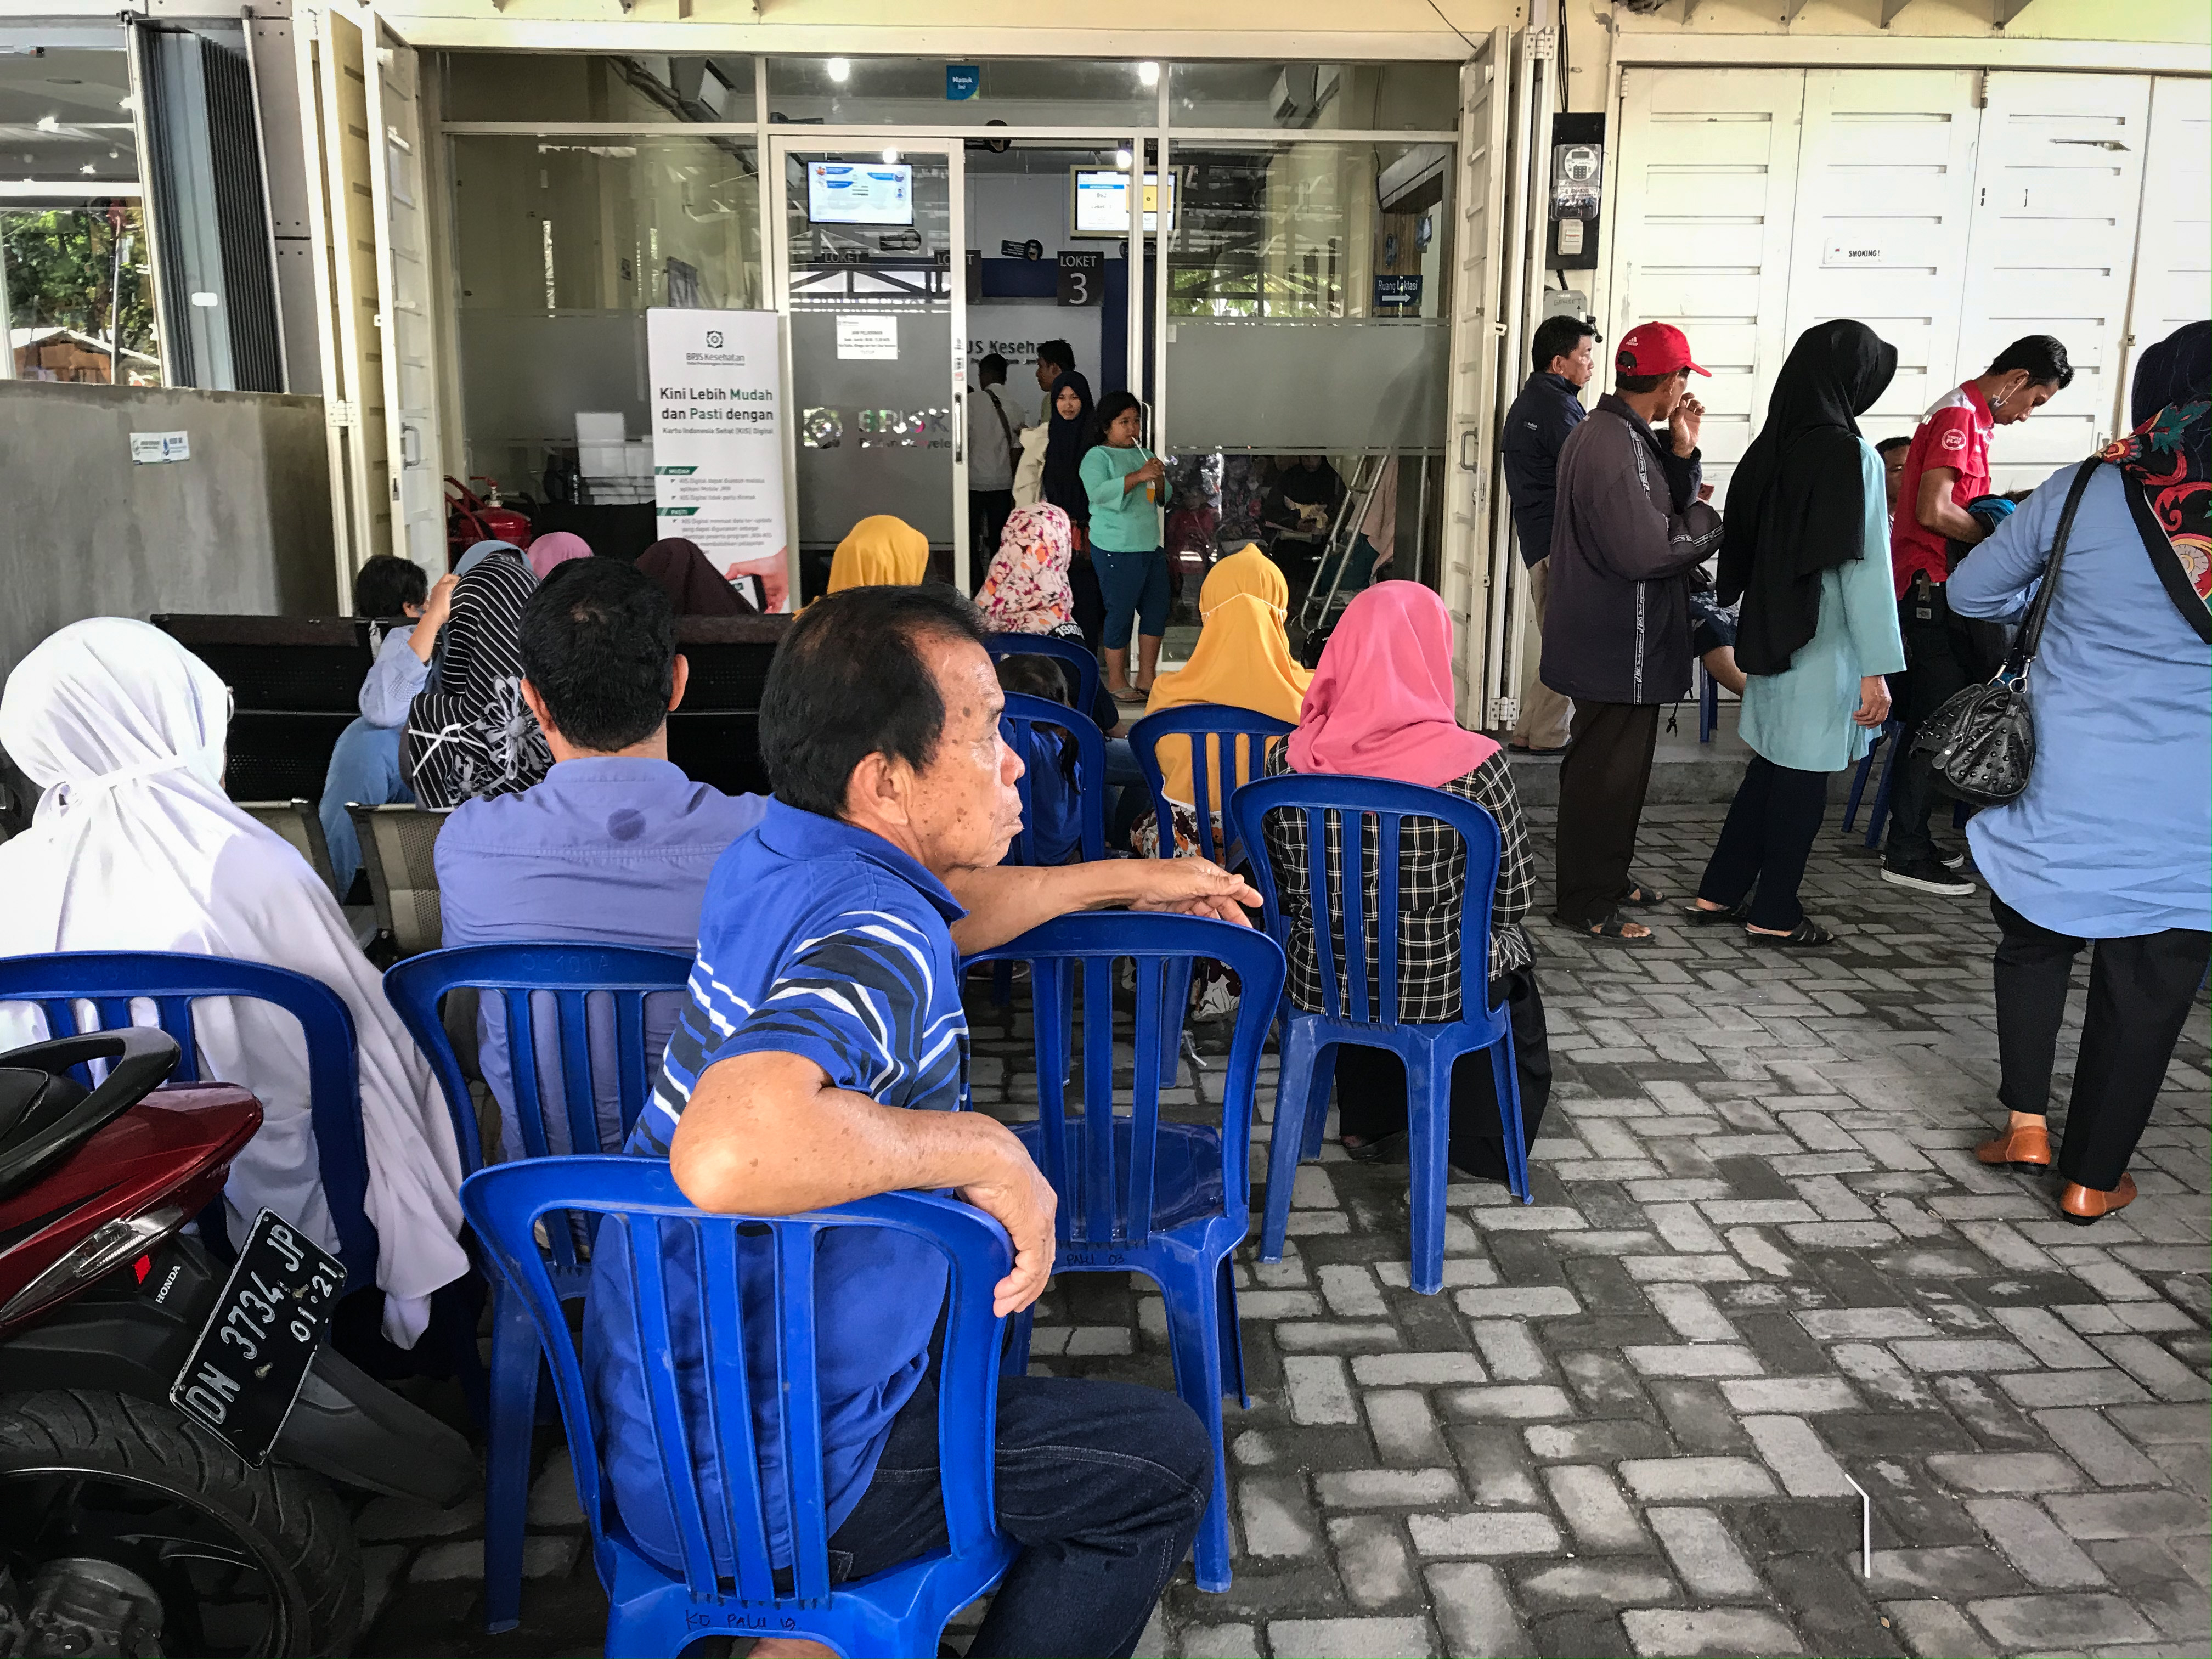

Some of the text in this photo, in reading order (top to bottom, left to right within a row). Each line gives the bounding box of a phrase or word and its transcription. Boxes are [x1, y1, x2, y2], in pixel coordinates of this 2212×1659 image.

[825, 251, 861, 263] LOKET
[937, 254, 974, 266] LOT
[1060, 256, 1097, 267] LOKET
[1069, 273, 1088, 304] 3
[1378, 280, 1418, 293] Ruang Laktasi
[989, 340, 1038, 354] Keseh
[704, 353, 746, 362] Kesehatan
[659, 387, 773, 400] Kini Lebih Mudah
[661, 407, 774, 423] dan Pasti dengan
[1066, 1253, 1124, 1267] PALU 03
[155, 1265, 182, 1304] HONDA
[185, 1224, 304, 1425] DN 3734 JP
[727, 1613, 766, 1629] PALU
